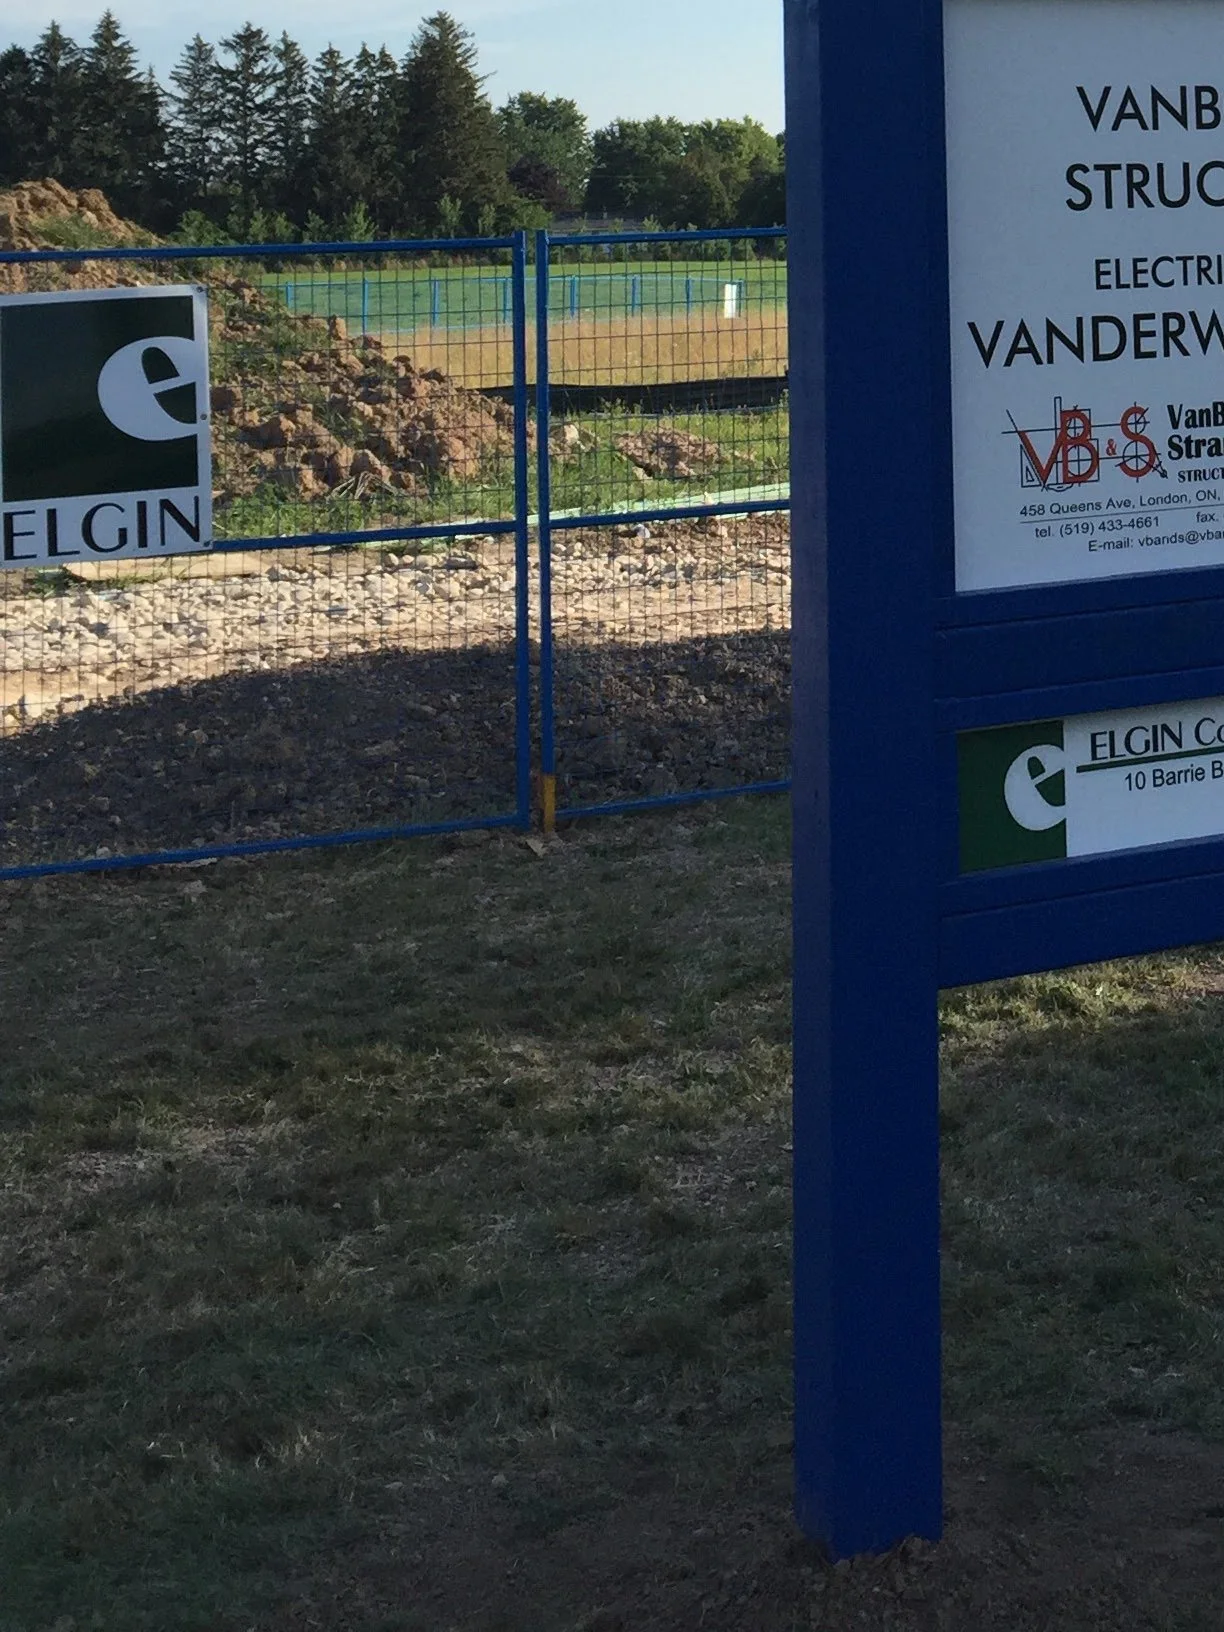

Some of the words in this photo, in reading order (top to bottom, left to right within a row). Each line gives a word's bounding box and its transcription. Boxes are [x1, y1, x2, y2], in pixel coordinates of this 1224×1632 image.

[1020, 504, 1045, 517] 458
[1050, 500, 1102, 515] Queens
[1106, 498, 1135, 510] Ave,
[1140, 493, 1191, 507] London,
[1196, 489, 1221, 502] ON,
[4, 495, 200, 561] ELGIN
[1059, 522, 1095, 538] (519)
[1098, 516, 1160, 532] 433-4661
[1088, 537, 1134, 552] E-mail:
[1090, 720, 1183, 761] ELGIN
[1124, 771, 1146, 791] 10
[1152, 763, 1205, 788] Barrie
